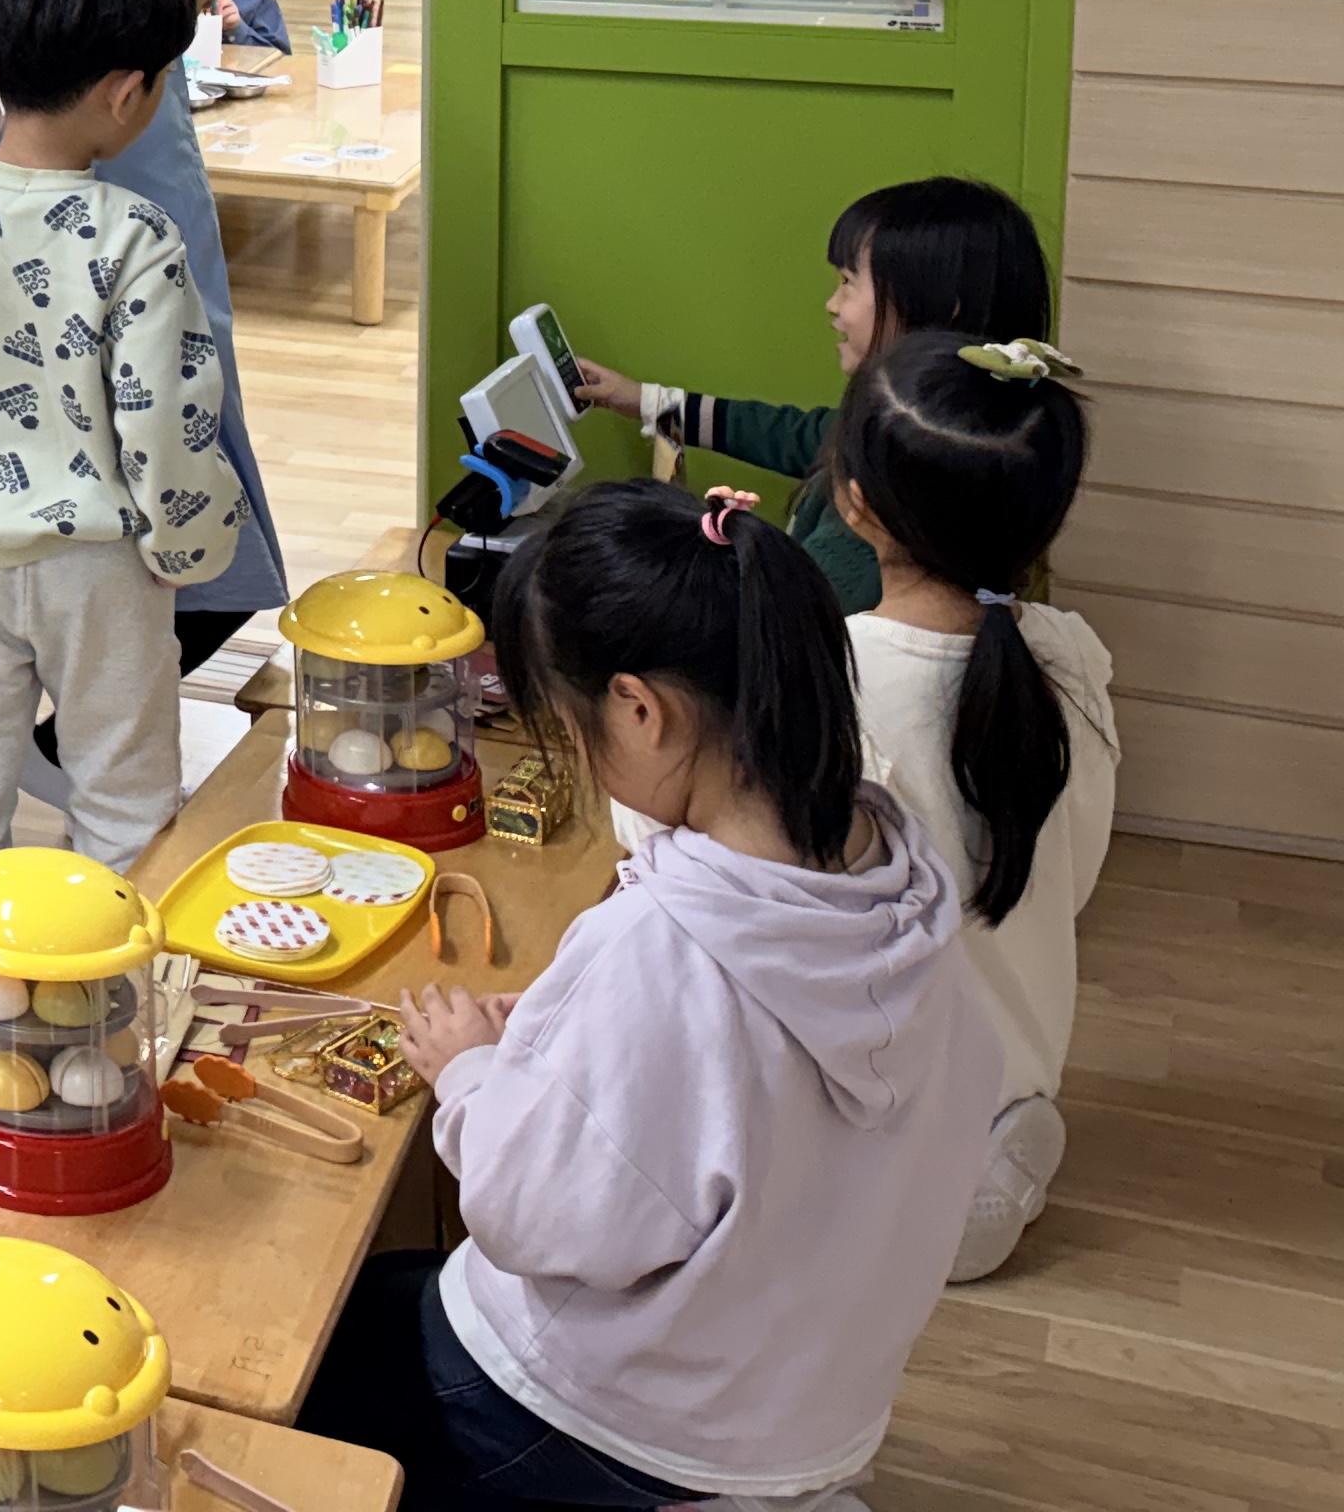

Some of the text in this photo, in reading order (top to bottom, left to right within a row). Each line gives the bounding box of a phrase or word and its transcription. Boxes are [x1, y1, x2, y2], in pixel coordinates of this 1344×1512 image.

[65, 212, 91, 235] Cold
[61, 331, 85, 358] Cold
[65, 318, 98, 356] outside
[7, 401, 38, 420] Cold
[183, 408, 211, 435] Cold
[166, 489, 190, 516] Cold
[167, 490, 205, 526] outside
